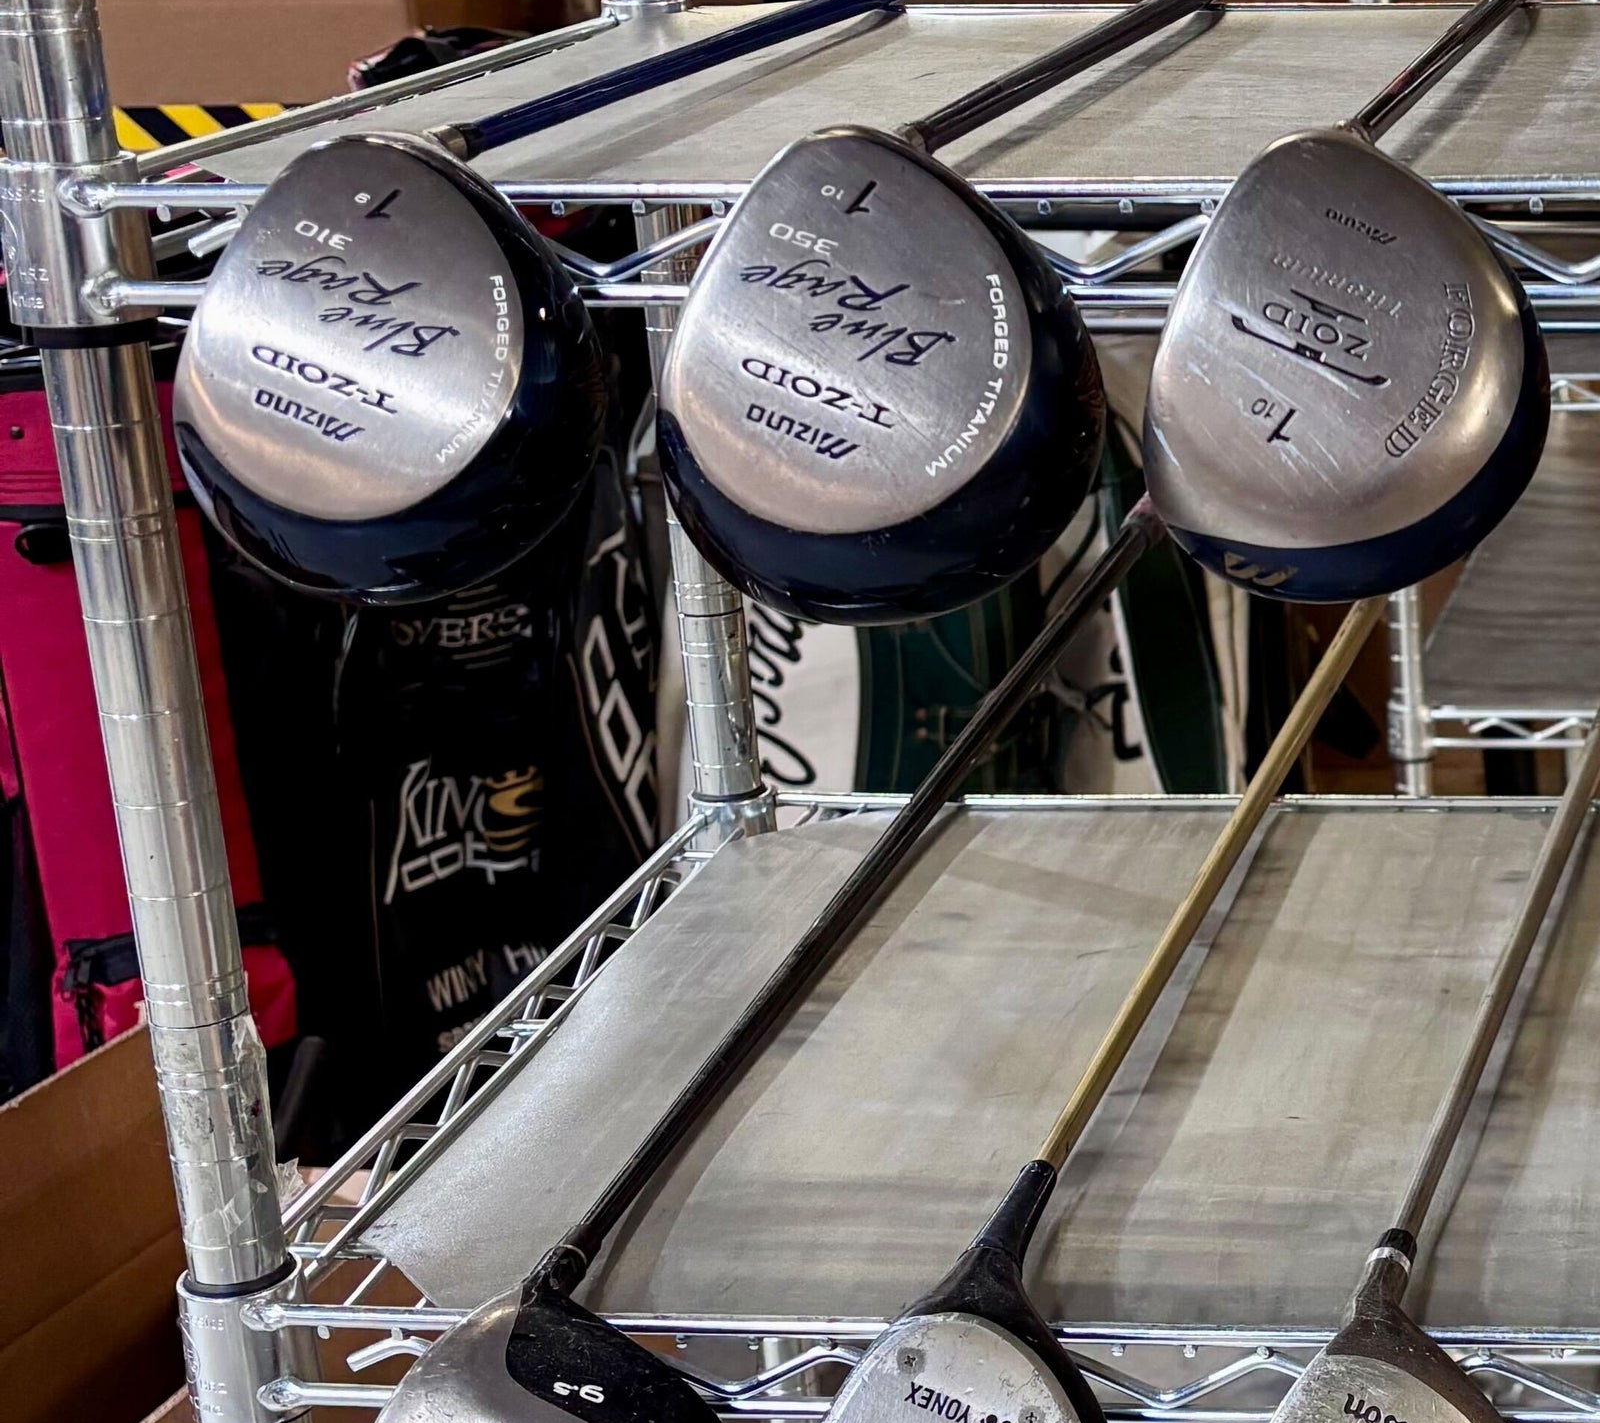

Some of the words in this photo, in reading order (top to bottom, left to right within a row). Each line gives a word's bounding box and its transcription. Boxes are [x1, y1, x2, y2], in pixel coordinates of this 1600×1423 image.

[365, 189, 400, 219] 1
[820, 184, 846, 200] 10
[844, 180, 877, 214] 1
[295, 220, 353, 250] 310
[769, 223, 839, 256] 350
[257, 255, 421, 305] Rage
[740, 259, 911, 311] Rage
[319, 306, 461, 357] Blue
[489, 275, 510, 361] FORGED
[808, 313, 957, 366] Blue
[985, 273, 1009, 370] FORGED
[252, 345, 398, 415] T-ZOID
[742, 358, 896, 429] T-ZOID
[1384, 281, 1476, 459] FORGED
[436, 369, 503, 463] TITANIUM
[925, 377, 1003, 477] TITANIUM
[1251, 398, 1276, 419] 10
[1267, 408, 1297, 443] 1
[553, 1381, 605, 1404] 9.5
[904, 1381, 974, 1423] YONEX
